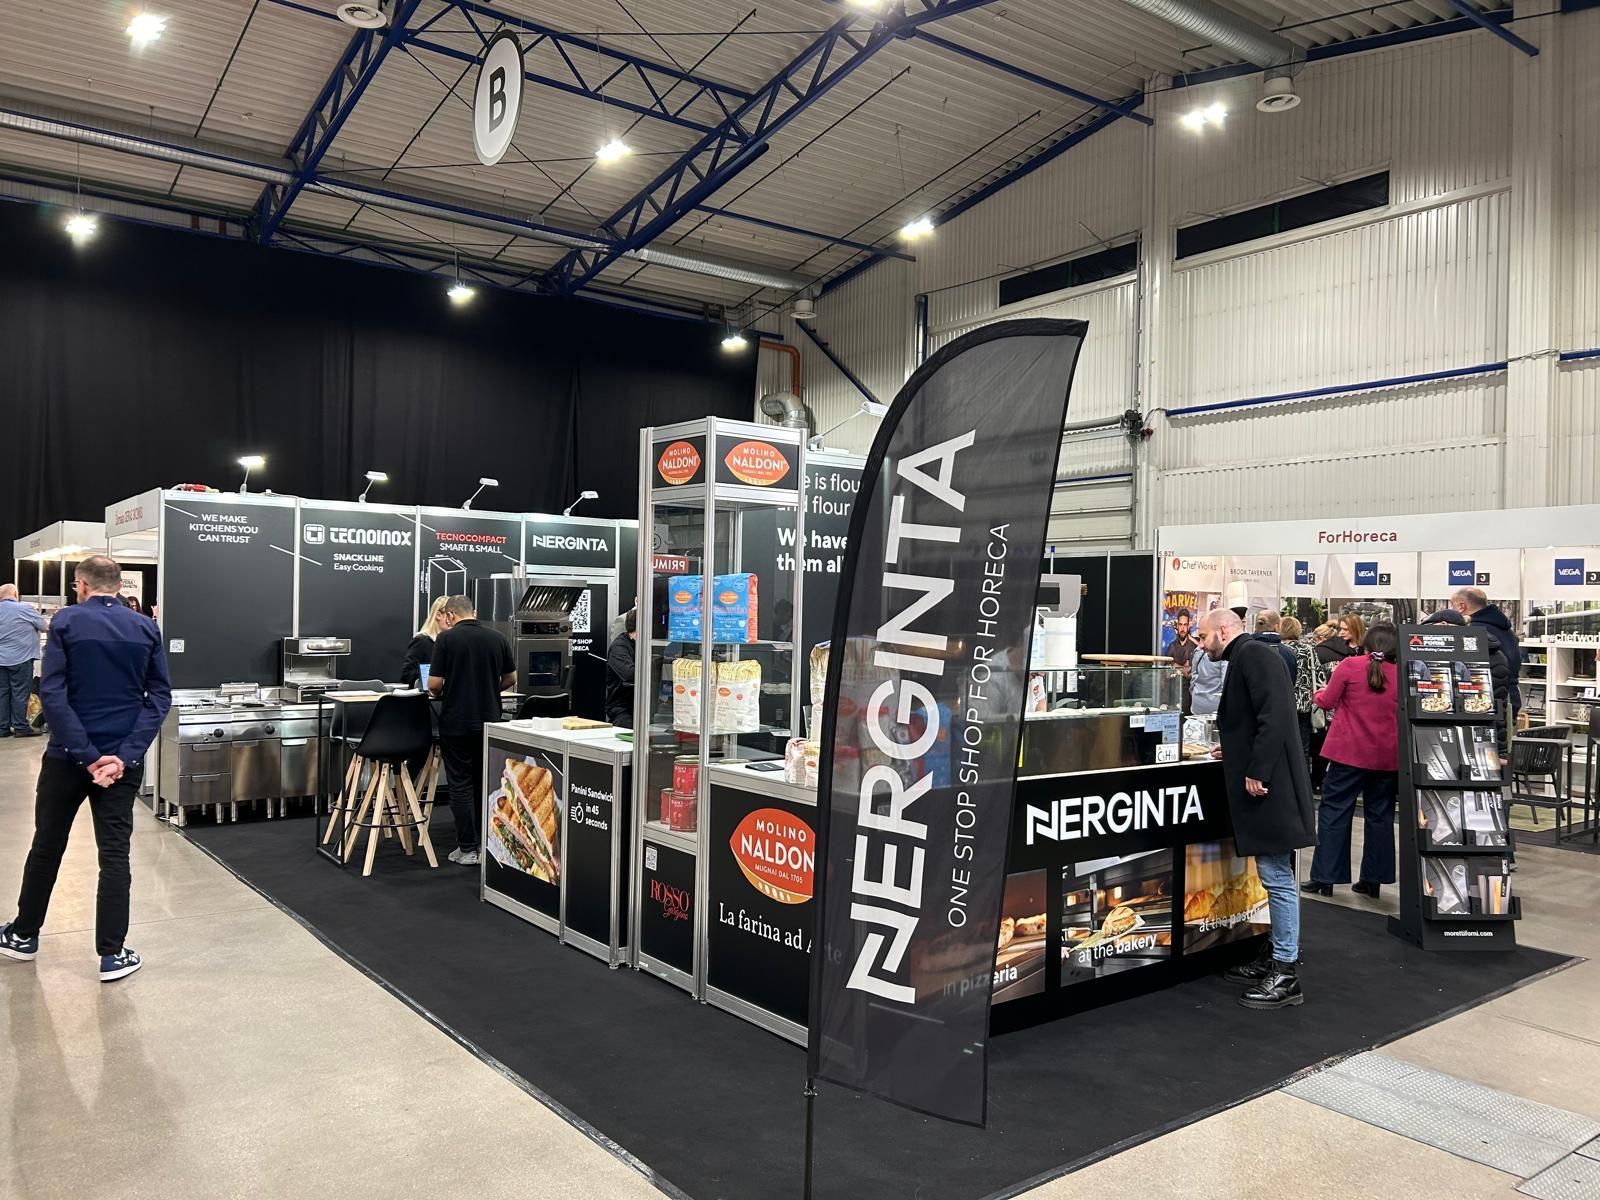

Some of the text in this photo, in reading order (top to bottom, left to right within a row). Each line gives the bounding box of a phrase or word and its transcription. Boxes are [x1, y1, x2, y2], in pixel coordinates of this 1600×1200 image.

[489, 66, 506, 133] B
[669, 448, 690, 456] MOLINO
[743, 448, 775, 457] MOLINO
[663, 456, 697, 469] NALDONI
[733, 456, 784, 470] NALDONI
[815, 473, 826, 490] is
[830, 473, 861, 493] flou
[812, 496, 850, 516] flour
[202, 514, 247, 523] WE MAKE
[189, 524, 258, 534] KITCHENS YOU
[1318, 530, 1397, 543] ForHoreca
[198, 534, 250, 543] CAN TRUST
[436, 532, 507, 544] TECNOCOMPACT
[533, 535, 608, 551] NERGINTA
[440, 543, 467, 551] SMART
[476, 545, 502, 553] SMALL
[333, 553, 384, 562] SNACK LINE
[334, 563, 384, 572] Easy Cooking
[846, 429, 976, 1004] NERGINTA
[947, 523, 1011, 928] ONE STOP SHOP FOR HORECA
[571, 783, 613, 803] Panini Sandwich
[586, 803, 599, 815] in 45
[1026, 785, 1204, 845] NERGINTA
[585, 817, 607, 830] seconds
[756, 819, 807, 842] MOLINO
[741, 833, 815, 872] NALDON
[755, 864, 803, 884] MUGNAI DAL 1705
[650, 879, 689, 912] ROSSO
[720, 902, 735, 926] La
[738, 909, 781, 943] farina
[784, 929, 803, 950] ad
[1200, 919, 1209, 932] at
[1211, 914, 1227, 929] the
[1078, 933, 1157, 963] at the bakery
